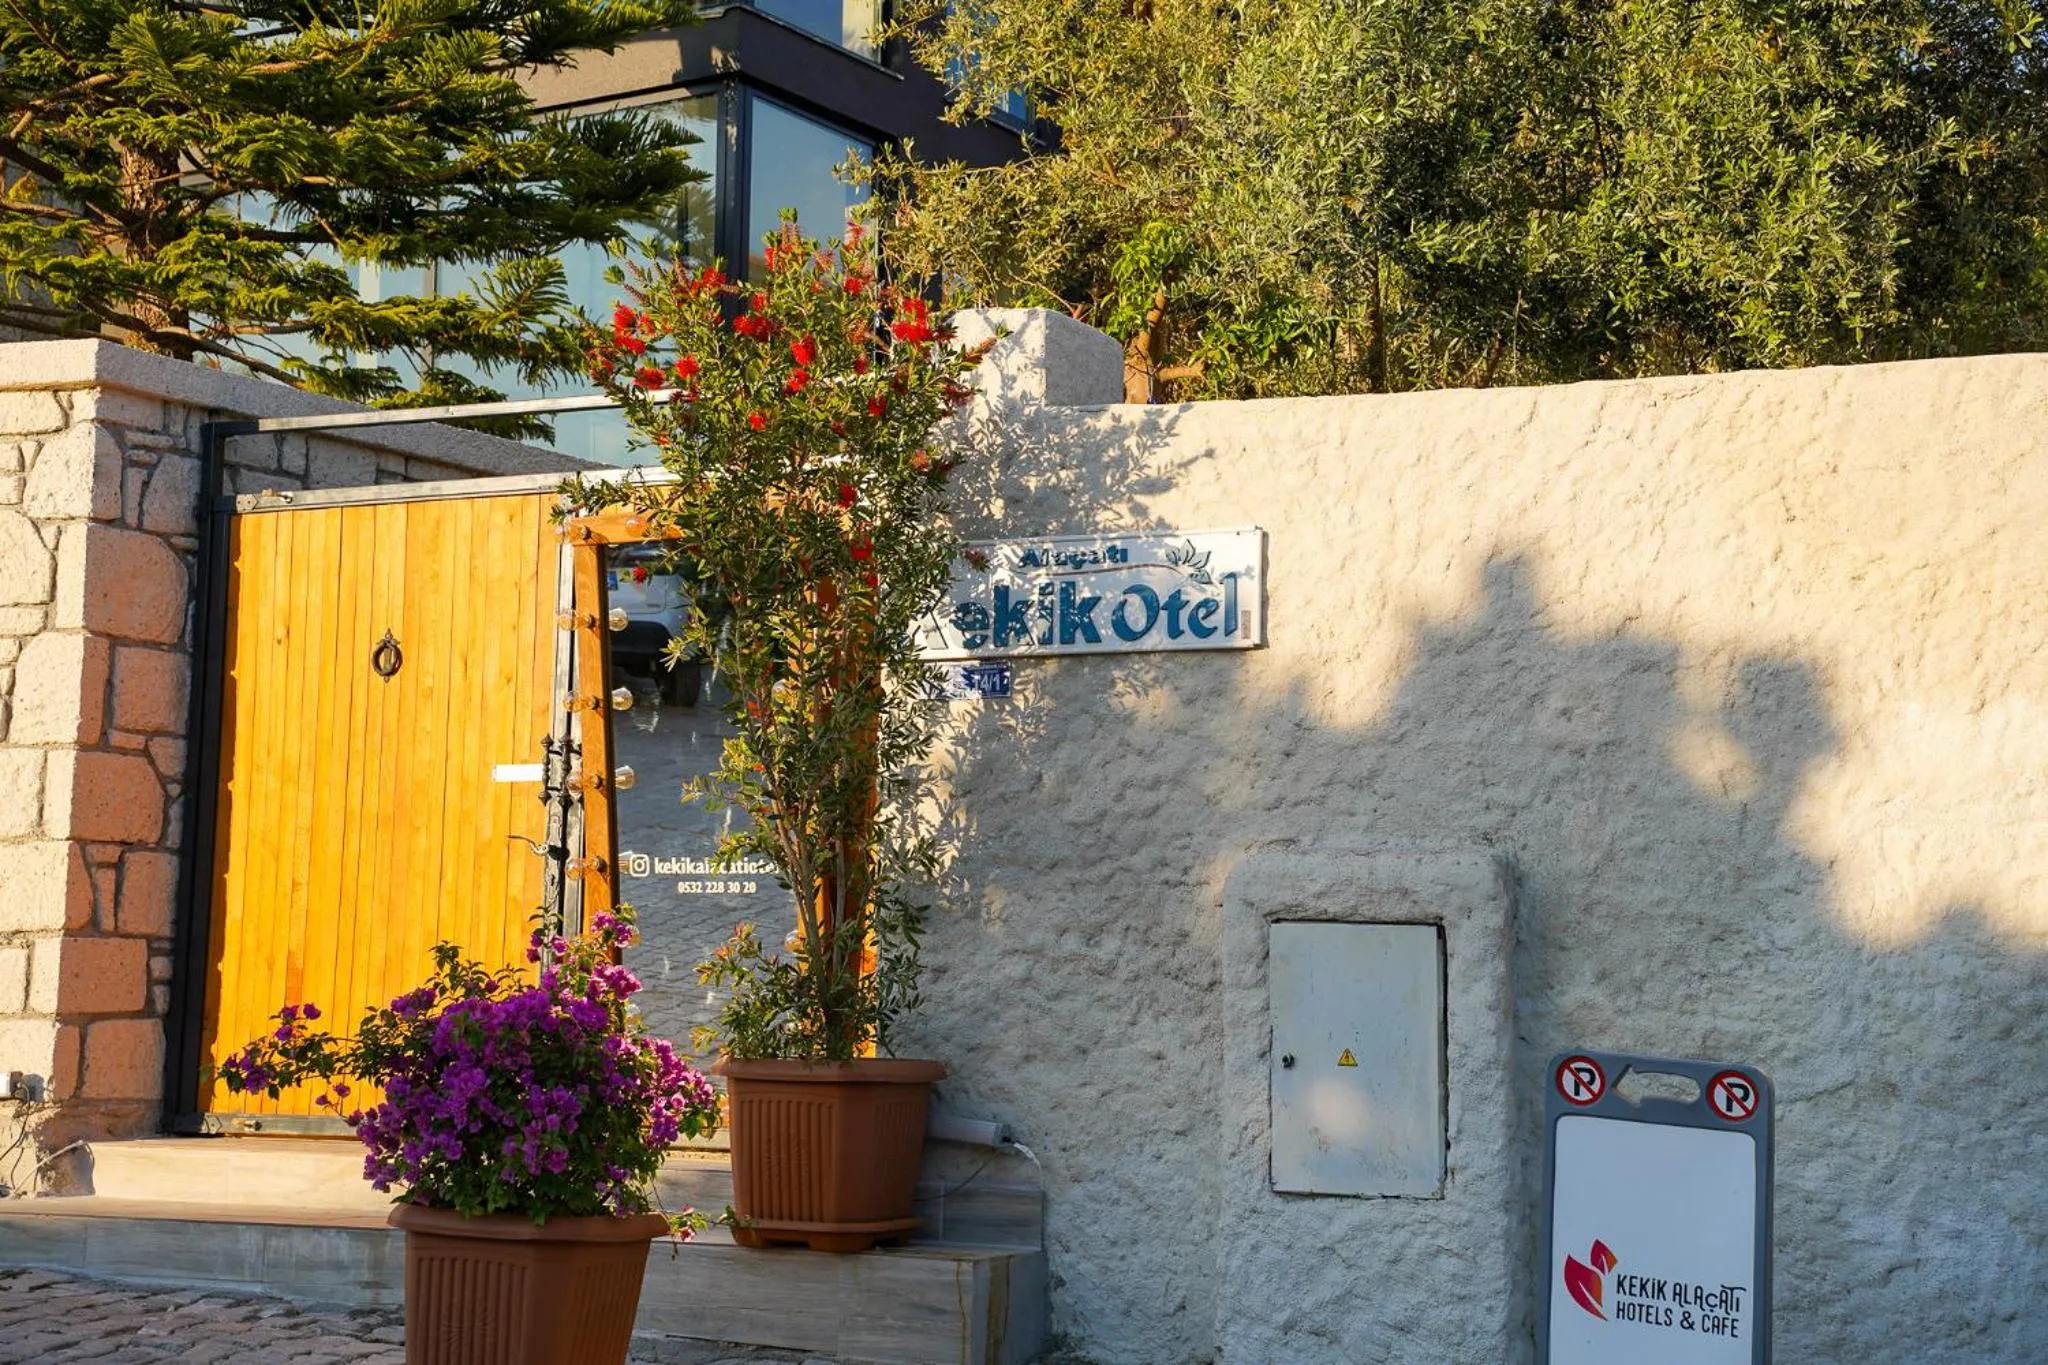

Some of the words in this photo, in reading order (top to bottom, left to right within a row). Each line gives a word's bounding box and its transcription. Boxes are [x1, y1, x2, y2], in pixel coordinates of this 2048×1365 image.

[1111, 572, 1239, 641] Otel
[677, 881, 702, 894] 0532
[706, 881, 725, 894] 228
[728, 881, 740, 894] 30
[1616, 1300, 1673, 1327] HOTELS
[1680, 1310, 1695, 1331] &
[1702, 1313, 1740, 1338] CAFE
